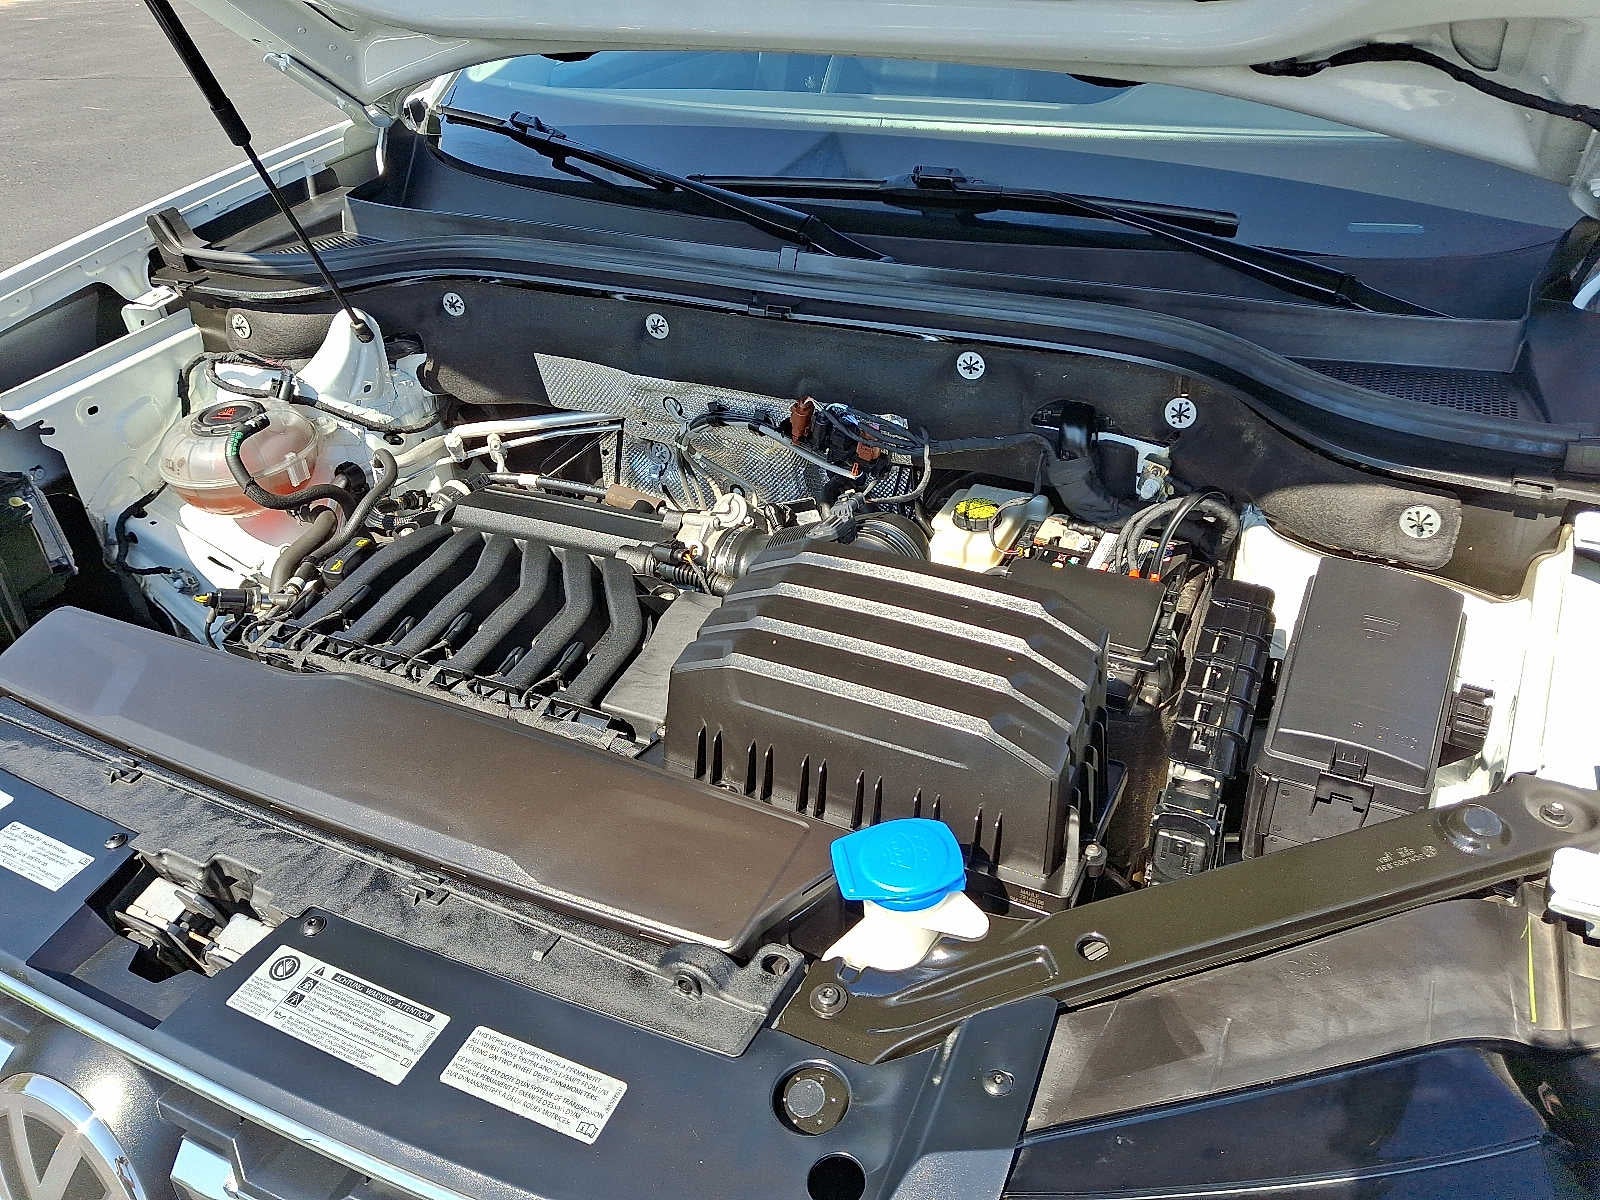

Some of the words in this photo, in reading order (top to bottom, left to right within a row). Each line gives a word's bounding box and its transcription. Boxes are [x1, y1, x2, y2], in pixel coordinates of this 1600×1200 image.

[335, 975, 365, 991] ACHTUNG
[366, 987, 396, 1005] WARNING
[396, 1001, 430, 1020] ATTENTION
